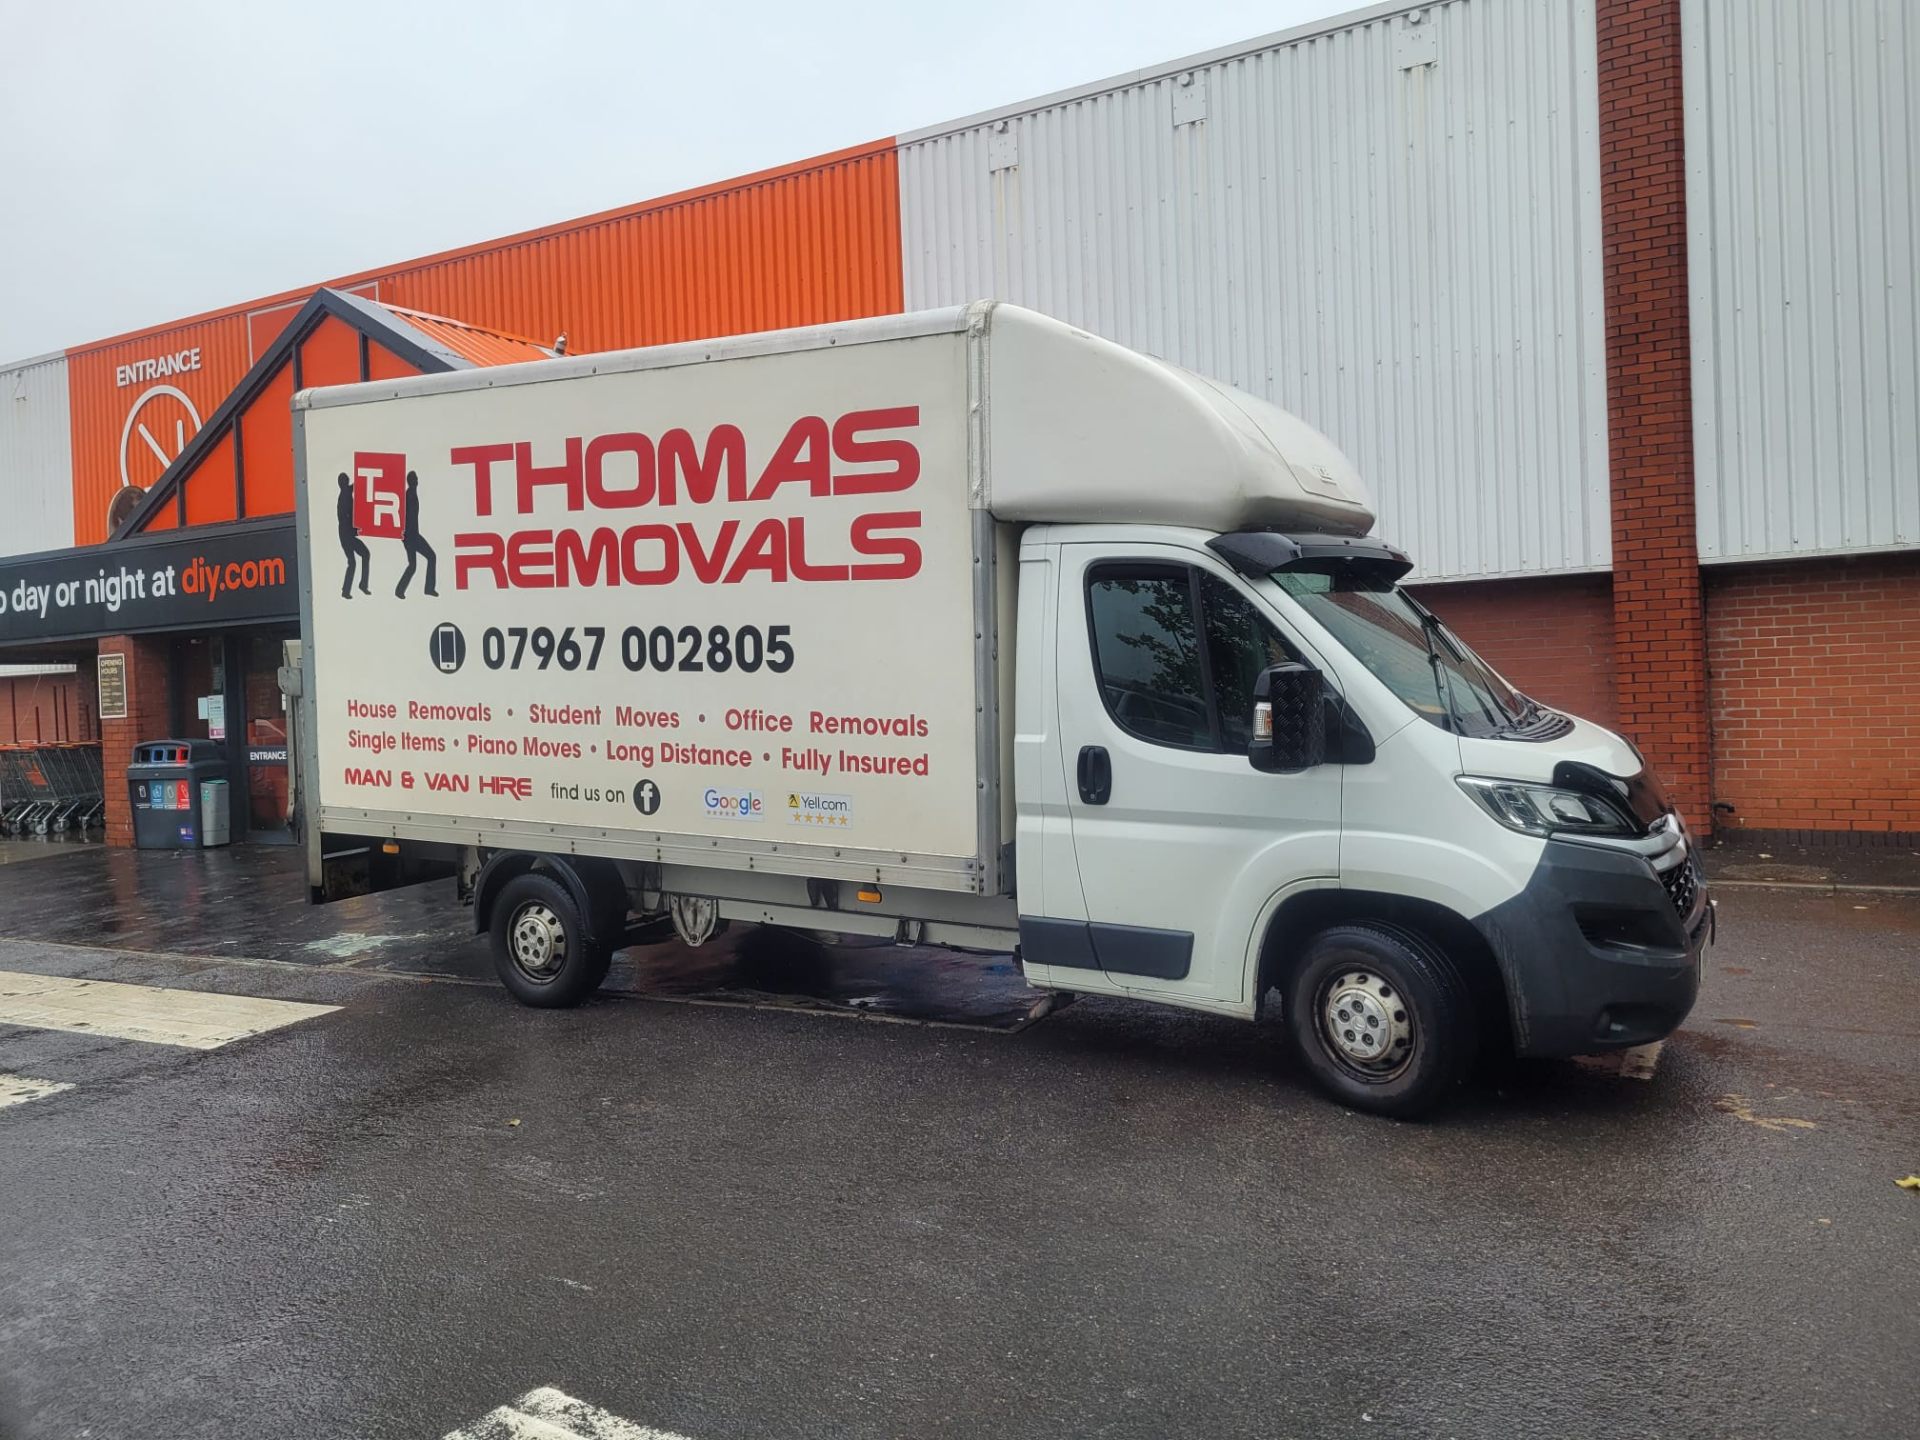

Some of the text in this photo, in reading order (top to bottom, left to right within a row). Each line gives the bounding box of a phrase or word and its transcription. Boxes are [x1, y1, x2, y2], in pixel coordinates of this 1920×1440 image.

[116, 347, 201, 387] ENTRANCE
[450, 406, 920, 517] THOMAS
[455, 511, 922, 590] REMOVALS
[12, 580, 50, 618] day
[55, 579, 80, 607] or
[86, 566, 146, 612] night
[152, 566, 176, 597] at
[182, 556, 285, 602] diy.com
[482, 625, 795, 674] 07967 002805
[348, 700, 928, 737] House Removals Student Moves Office Removals
[250, 751, 287, 761] ENTRANCE
[348, 730, 929, 776] Single Items Piano Moves Long Distance Fully Insured
[344, 768, 532, 801] MAN & VAN HIRE
[550, 783, 579, 801] find
[584, 786, 601, 801] us
[605, 789, 625, 803] on
[705, 789, 762, 815] Google
[801, 796, 848, 812] Yell.com
